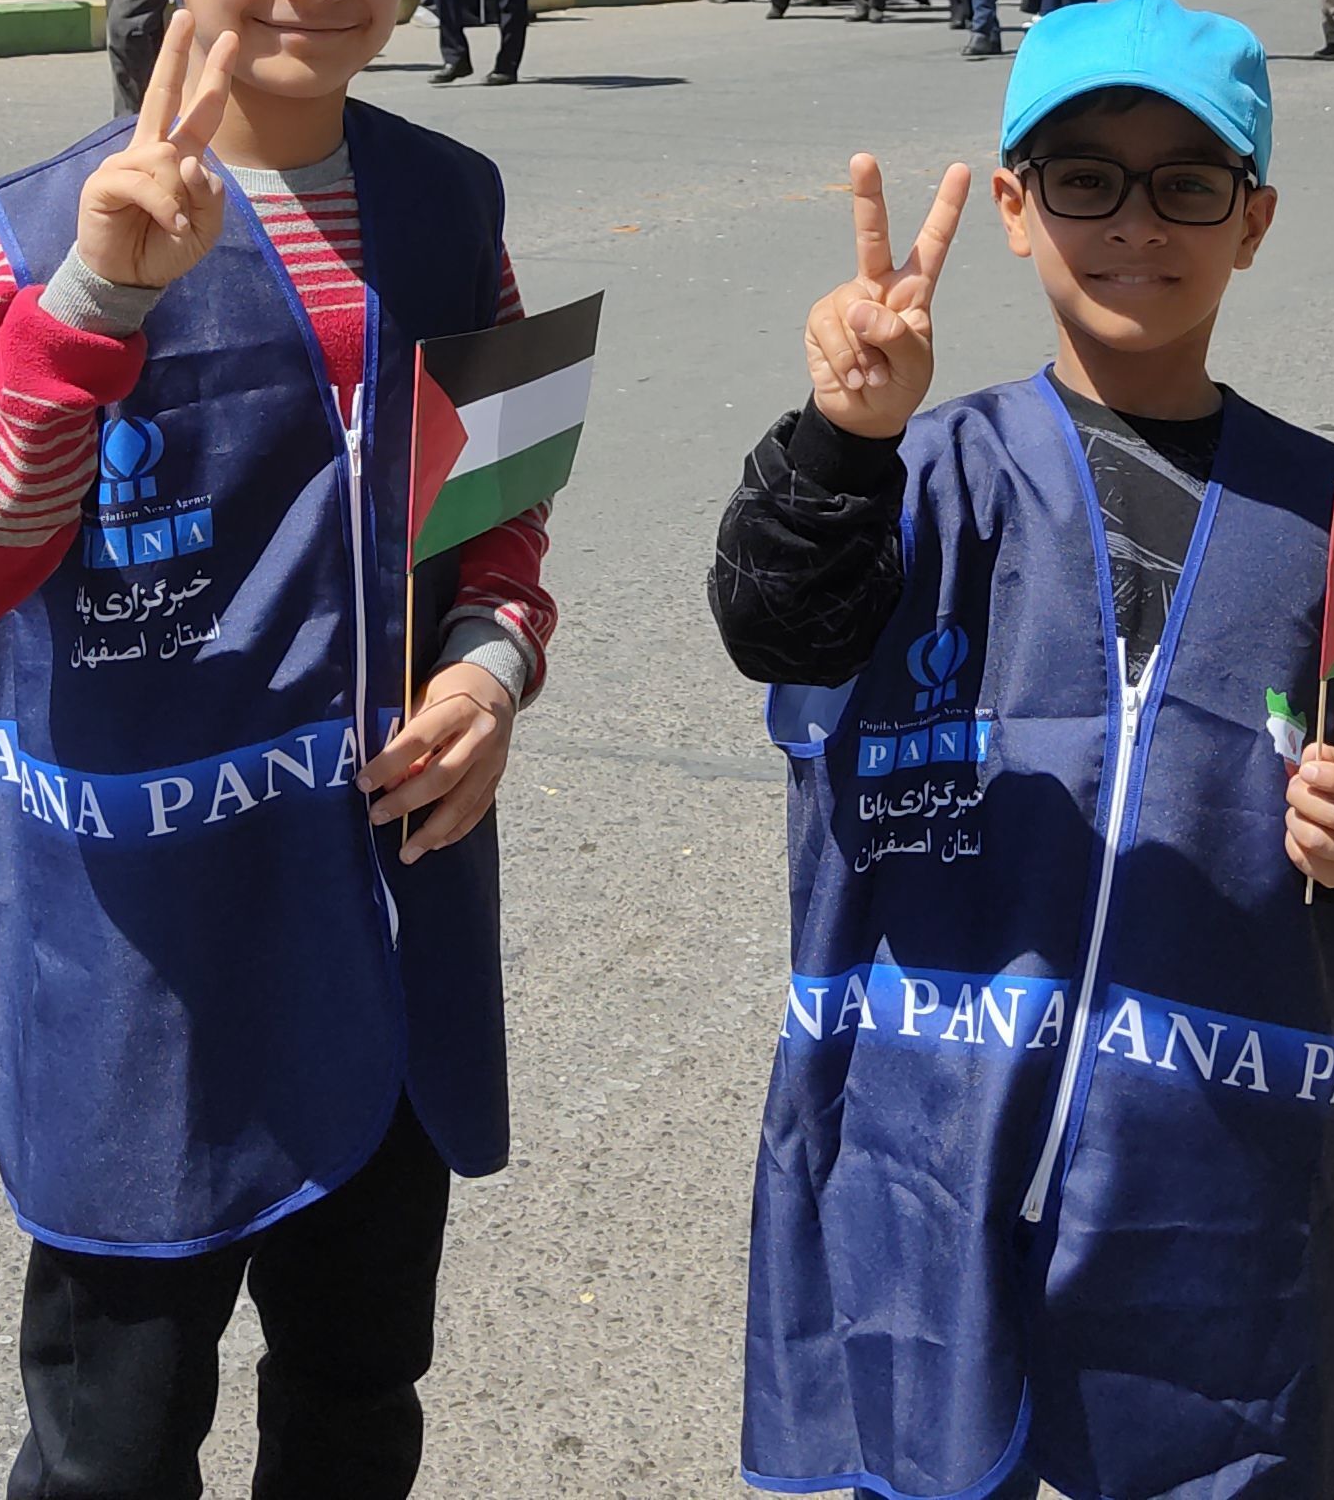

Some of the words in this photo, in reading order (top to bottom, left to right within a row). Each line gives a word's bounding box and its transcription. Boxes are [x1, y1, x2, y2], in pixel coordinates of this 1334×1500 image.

[176, 493, 213, 510] Agency
[86, 521, 206, 563] ANA
[93, 569, 213, 623] خبرگزاری
[70, 630, 148, 669] اصفهان
[159, 612, 221, 660] استان
[140, 726, 357, 837] PANA
[886, 779, 984, 819] خبرگزاری
[858, 791, 889, 825] پانا
[853, 827, 932, 873] اصفهان
[897, 978, 1066, 1050] PANA
[1097, 996, 1270, 1093] ANA
